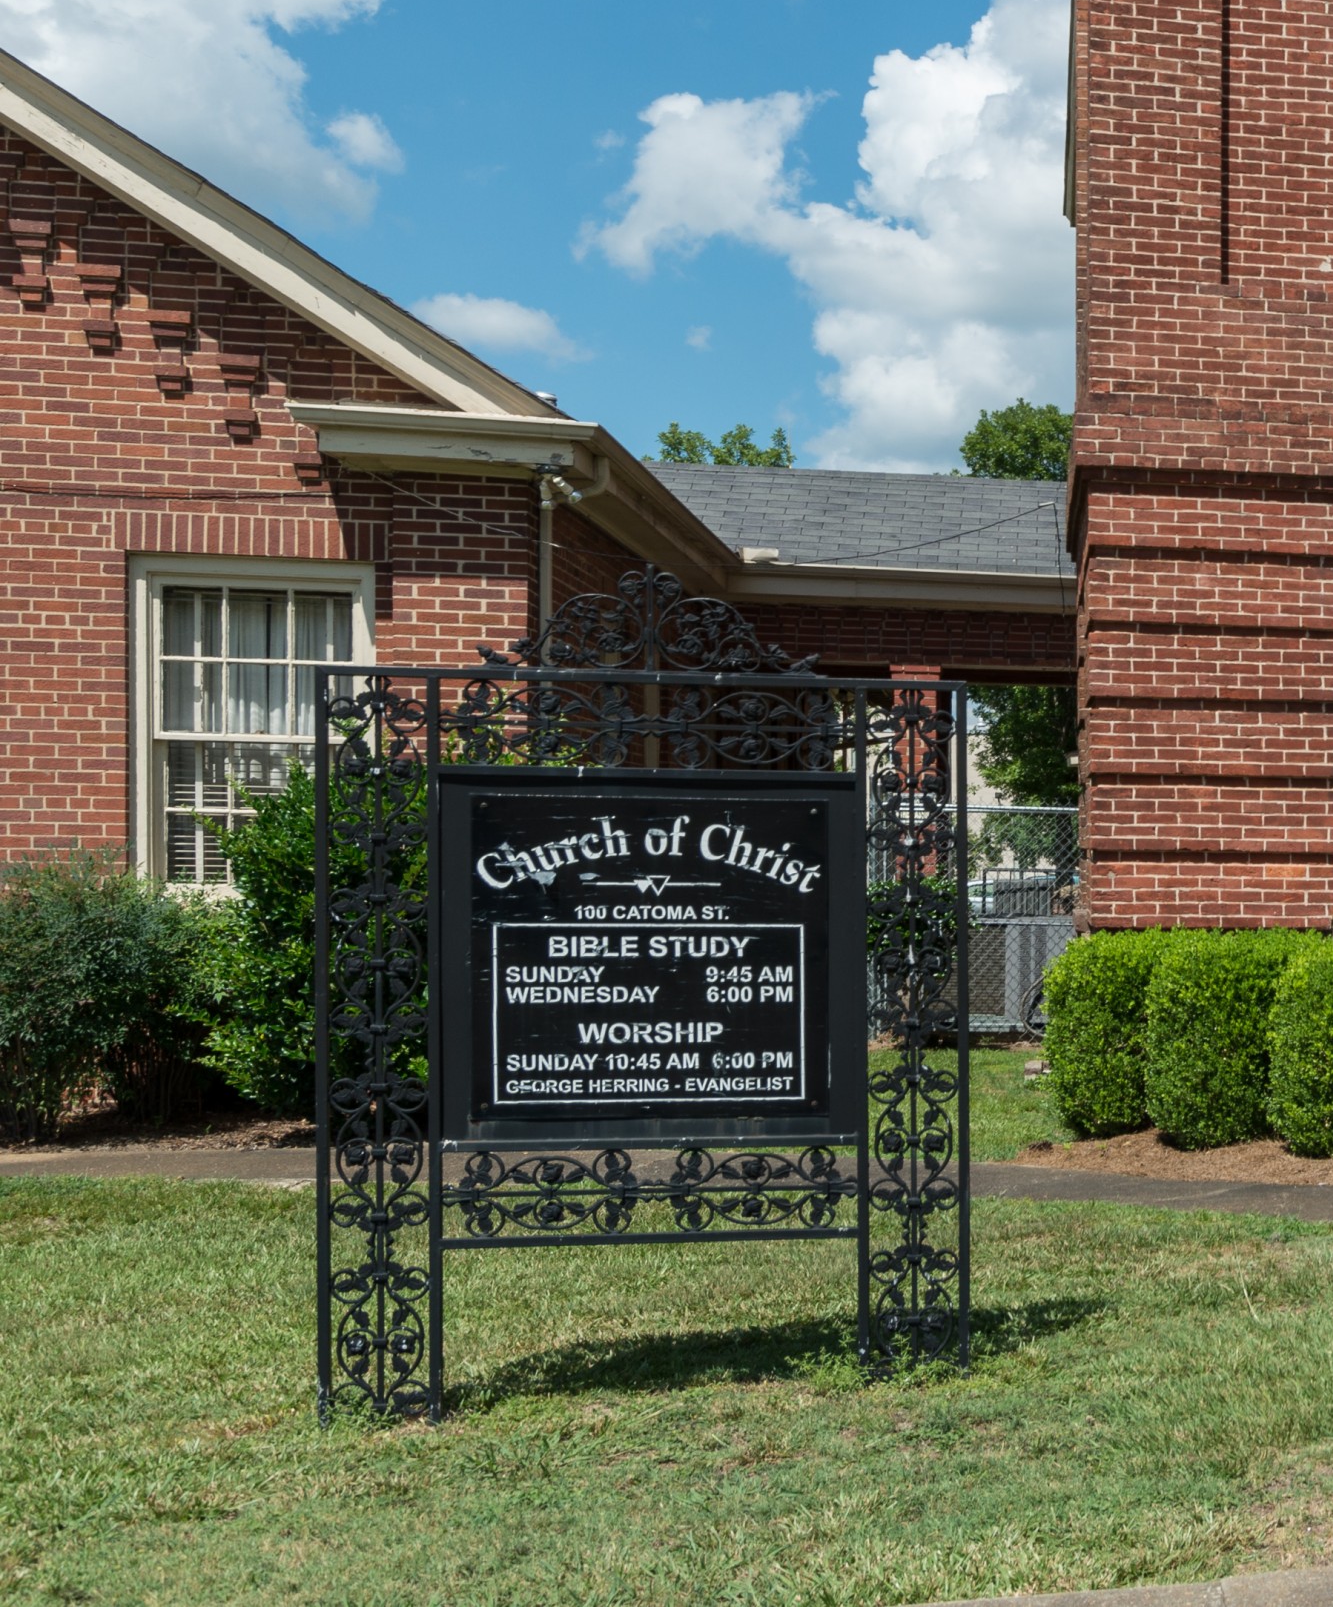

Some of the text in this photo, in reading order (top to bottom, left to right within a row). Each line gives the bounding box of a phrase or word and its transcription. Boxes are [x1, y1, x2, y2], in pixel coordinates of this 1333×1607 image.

[475, 814, 822, 894] Church of Christ
[574, 904, 730, 921] 100 CATOMA ST.
[547, 935, 751, 958] BIBLE STUDY
[505, 965, 794, 983] SUNDAY 9:45 AM
[505, 985, 794, 1004] WEDNESDAY 6:00 PM
[578, 1021, 724, 1044] WORSHIP
[506, 1051, 794, 1072] SUNDAY 10:45 AM 6:00 PM
[505, 1079, 584, 1095] GEORGE
[588, 1077, 670, 1094] HERRING
[684, 1076, 794, 1093] EVANGELIST
